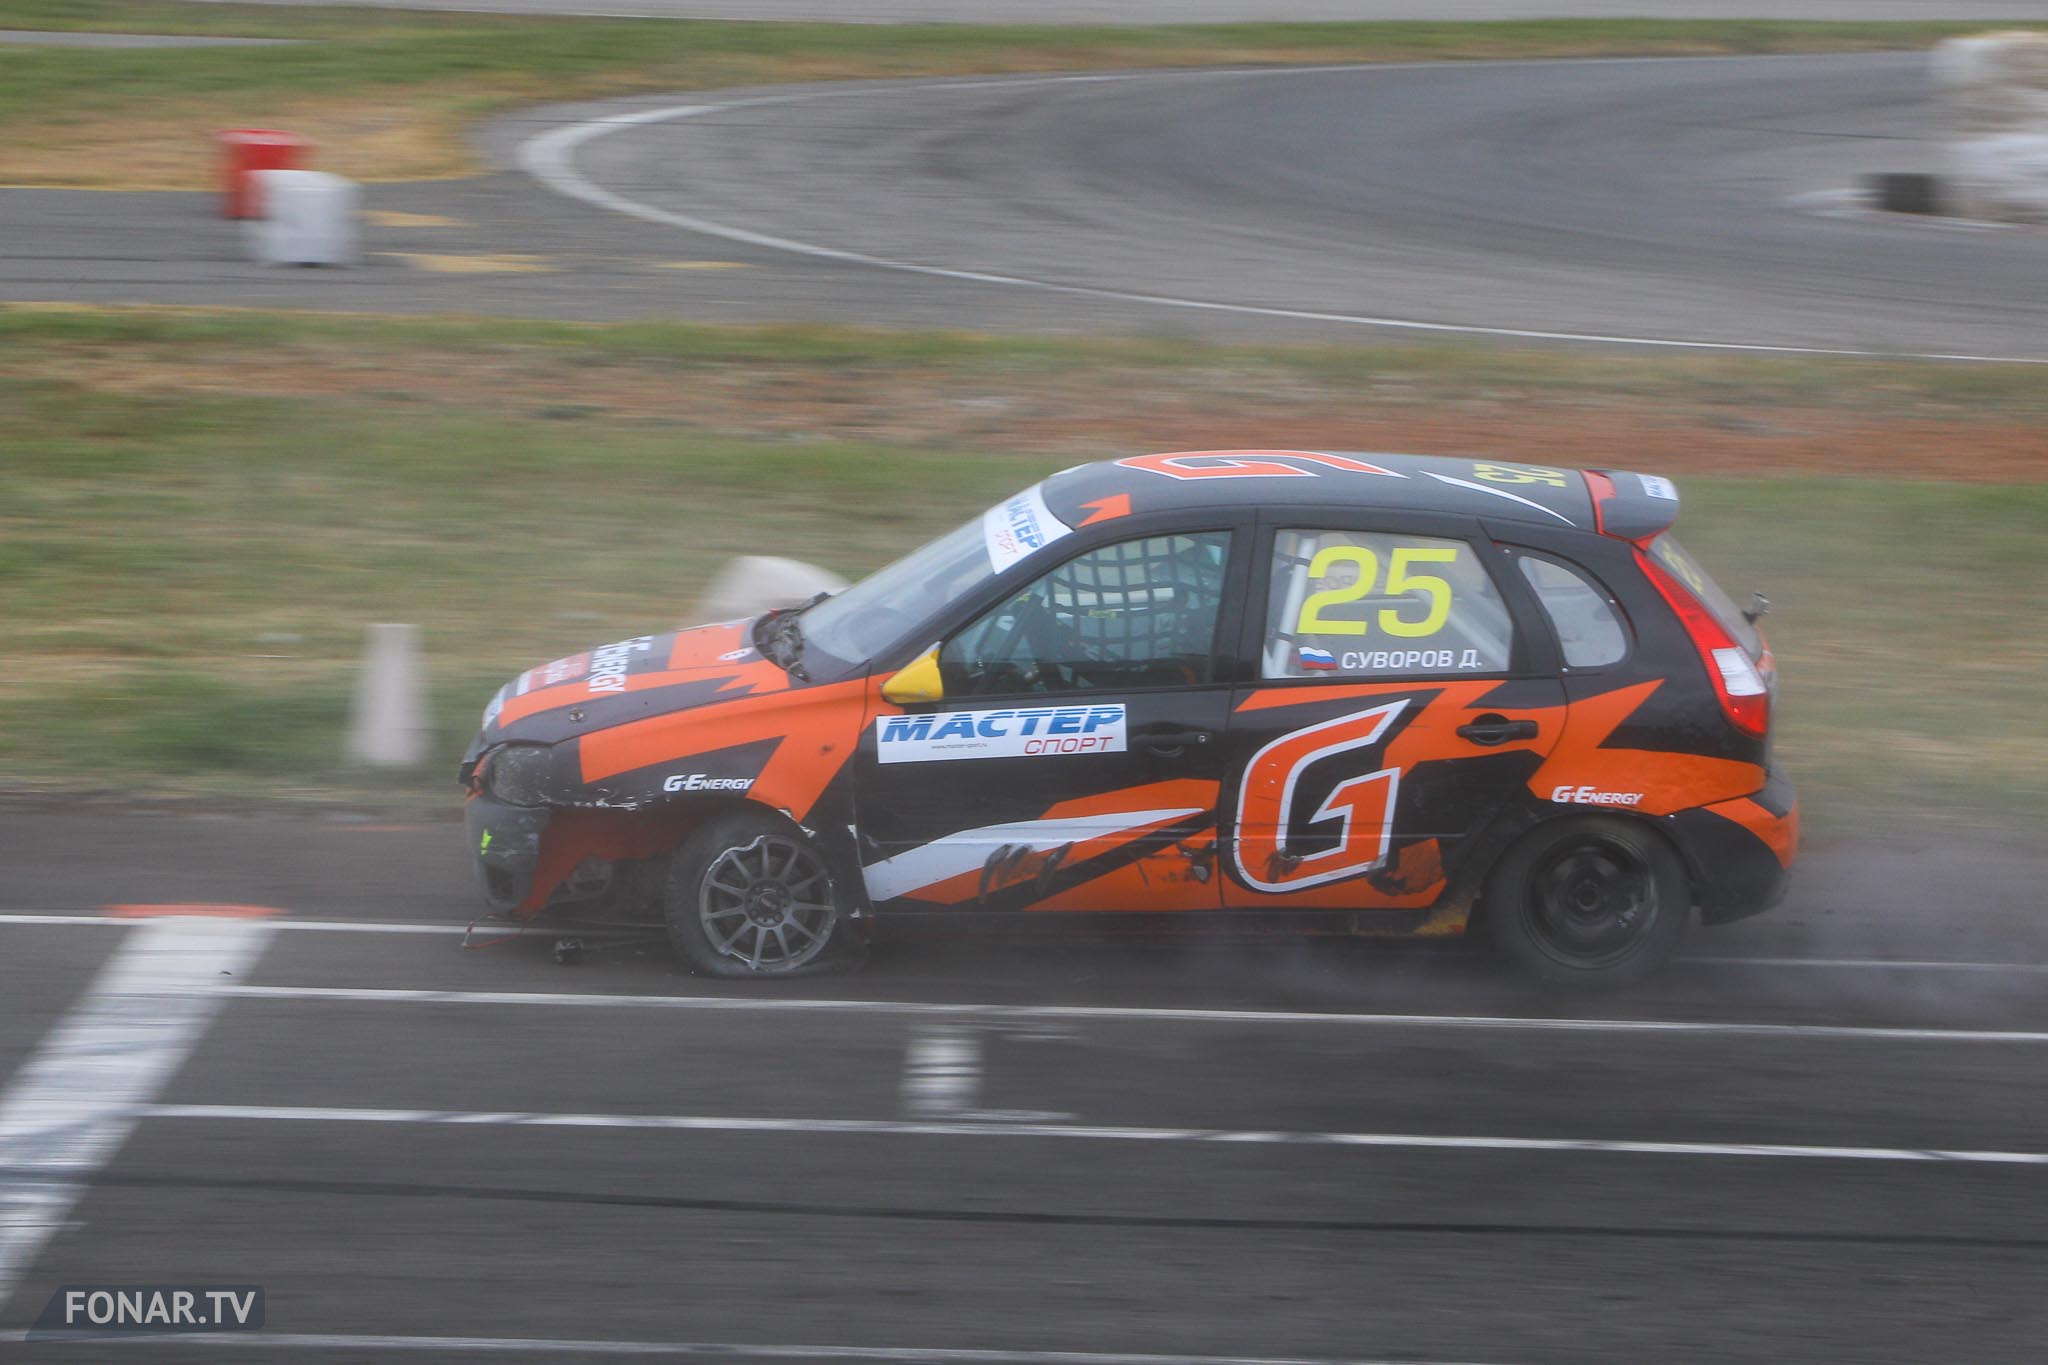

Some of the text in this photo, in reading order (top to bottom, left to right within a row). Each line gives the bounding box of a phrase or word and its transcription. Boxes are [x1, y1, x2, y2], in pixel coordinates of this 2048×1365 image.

[1296, 546, 1457, 637] 25
[1341, 649, 1482, 669] СУВОРОВ Д.
[881, 706, 1124, 742] МАСТЕР
[1023, 736, 1114, 755] СПОРТ
